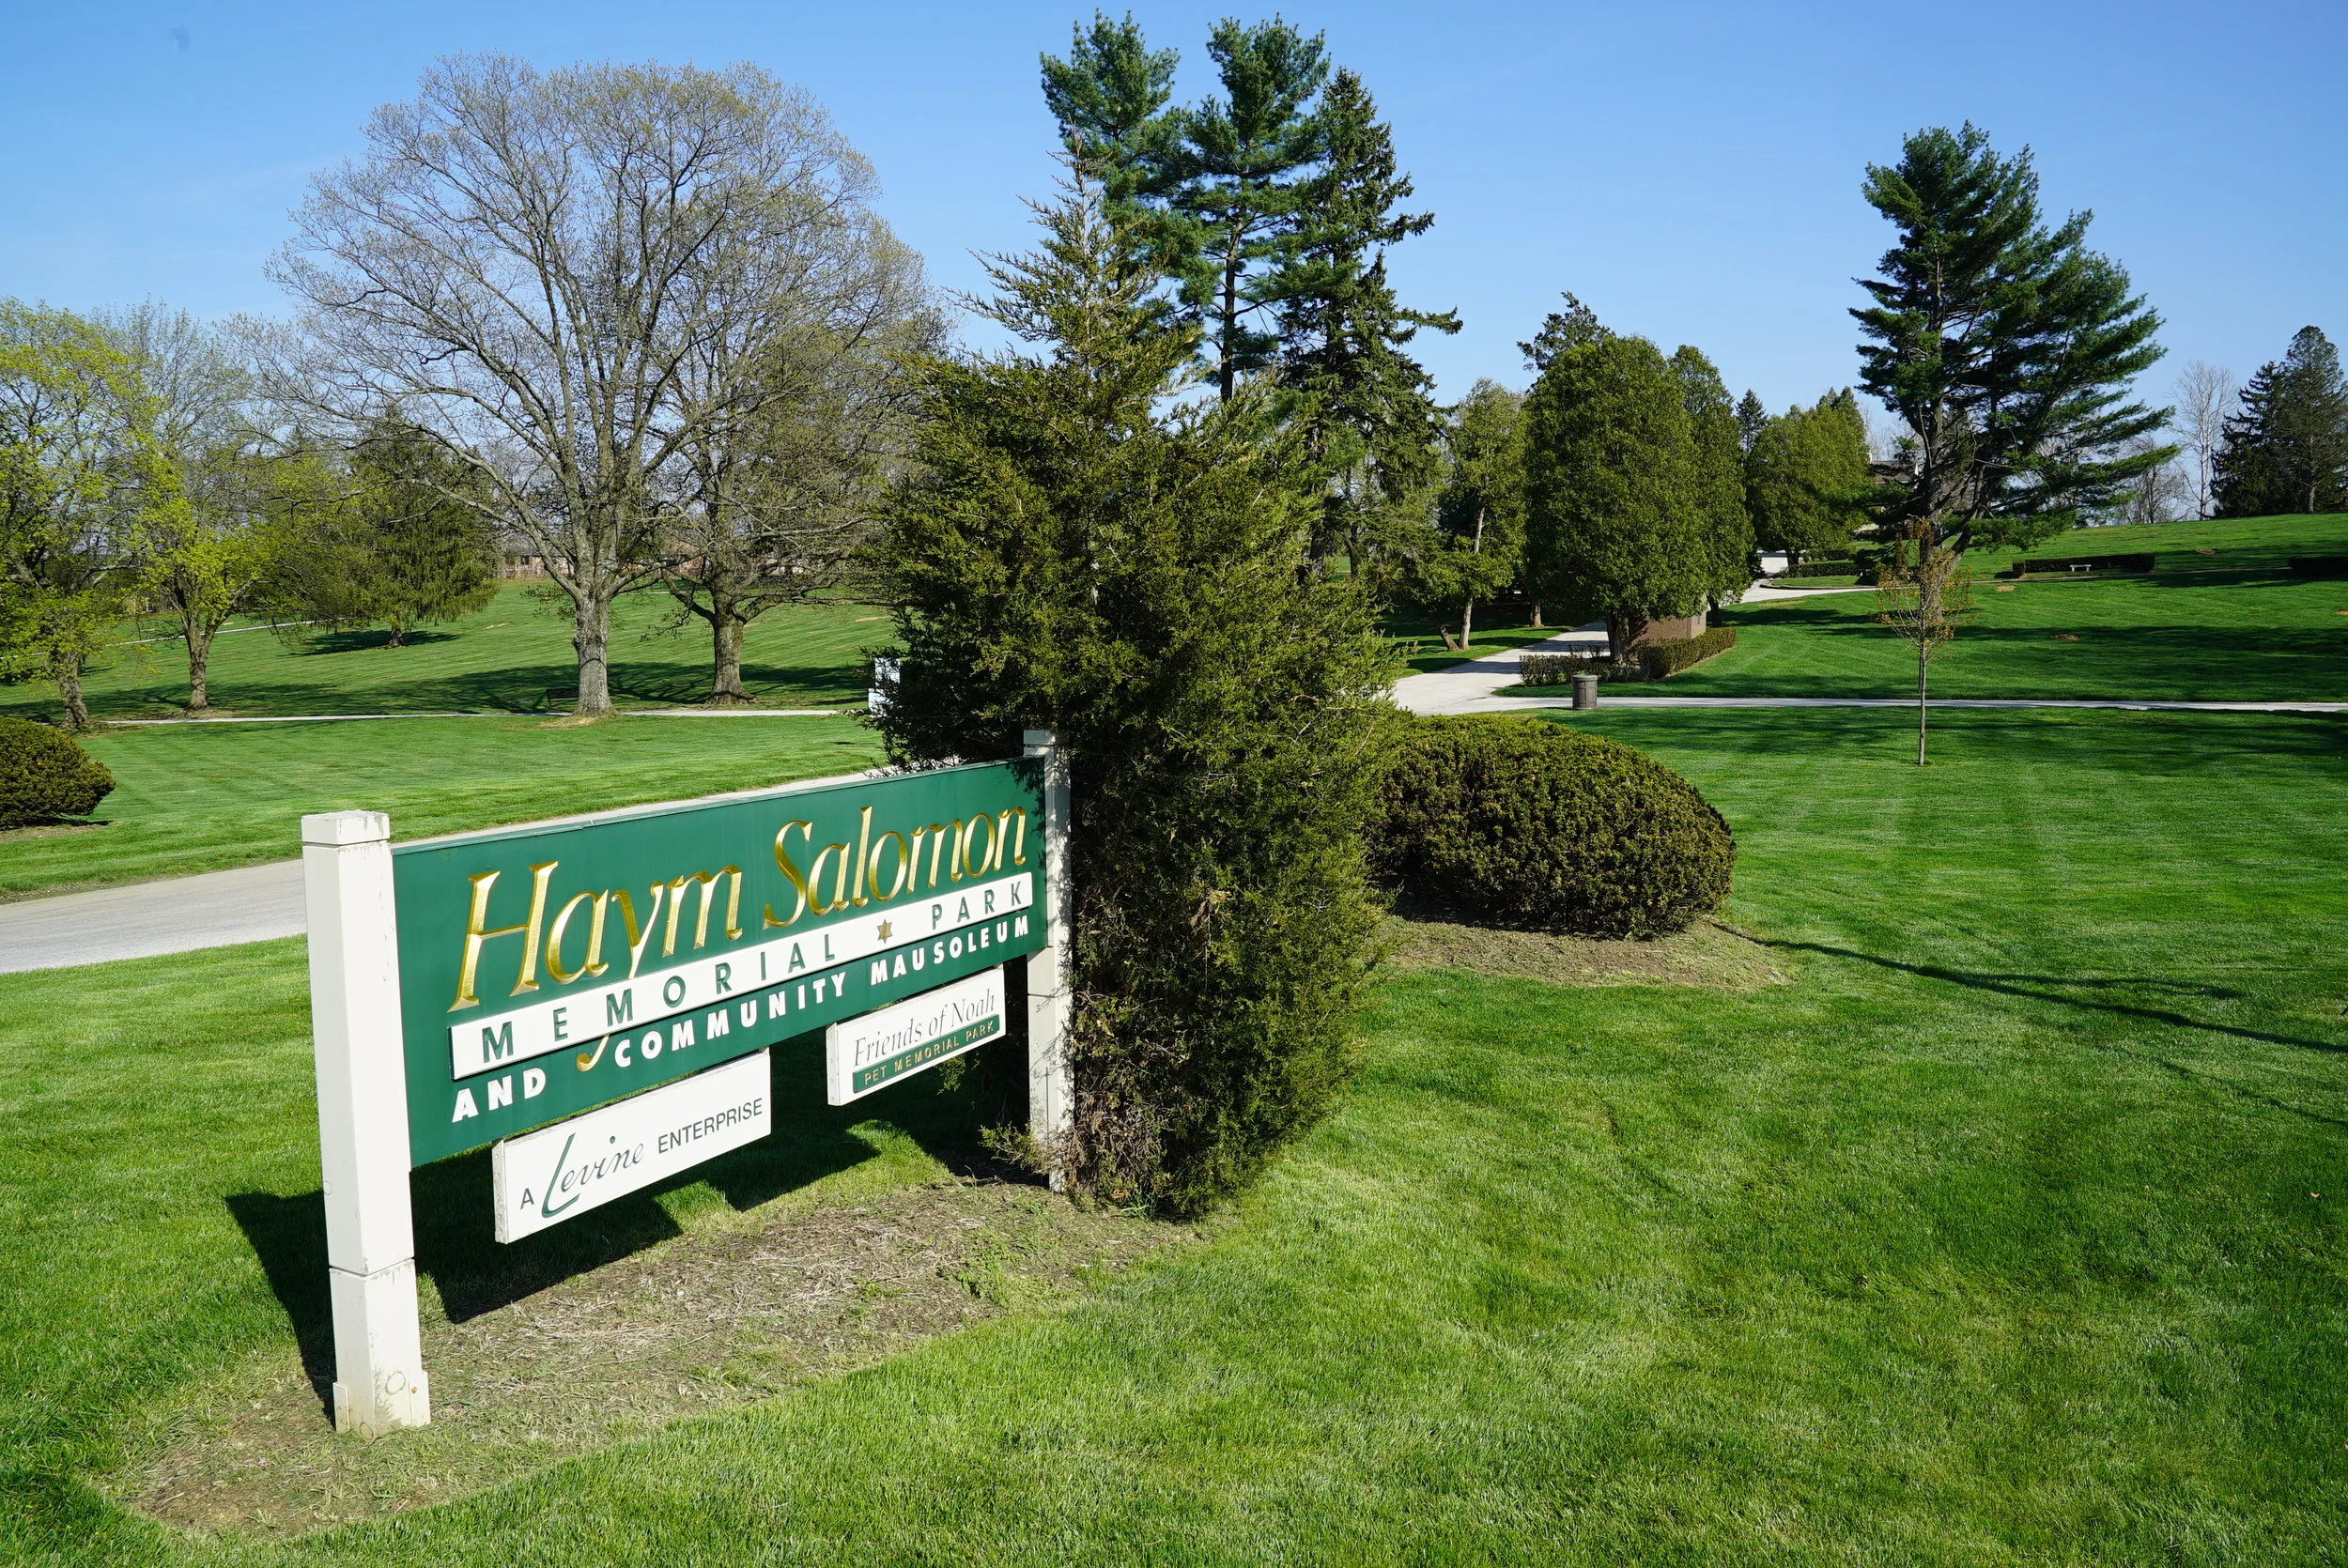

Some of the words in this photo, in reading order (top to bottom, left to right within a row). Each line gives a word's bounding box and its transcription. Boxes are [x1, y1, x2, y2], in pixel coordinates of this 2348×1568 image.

[447, 860, 743, 1071] Haym
[764, 805, 1027, 930] Salomon
[482, 933, 836, 1063] MEMORIAL
[931, 882, 1024, 930] PARK
[452, 1067, 548, 1123] AND
[614, 970, 847, 1068] COMMUNITY
[871, 915, 1029, 986] MAUSOLEUM
[854, 1018, 922, 1067] Friends
[928, 1004, 948, 1036] of
[950, 988, 996, 1028] Noah
[864, 1065, 888, 1085] PET
[894, 1036, 960, 1072] MEMORIAL
[965, 1020, 995, 1042] PARK
[519, 1187, 535, 1209] A
[541, 1132, 644, 1219] Levine
[657, 1098, 763, 1154] ENTERPRISE
